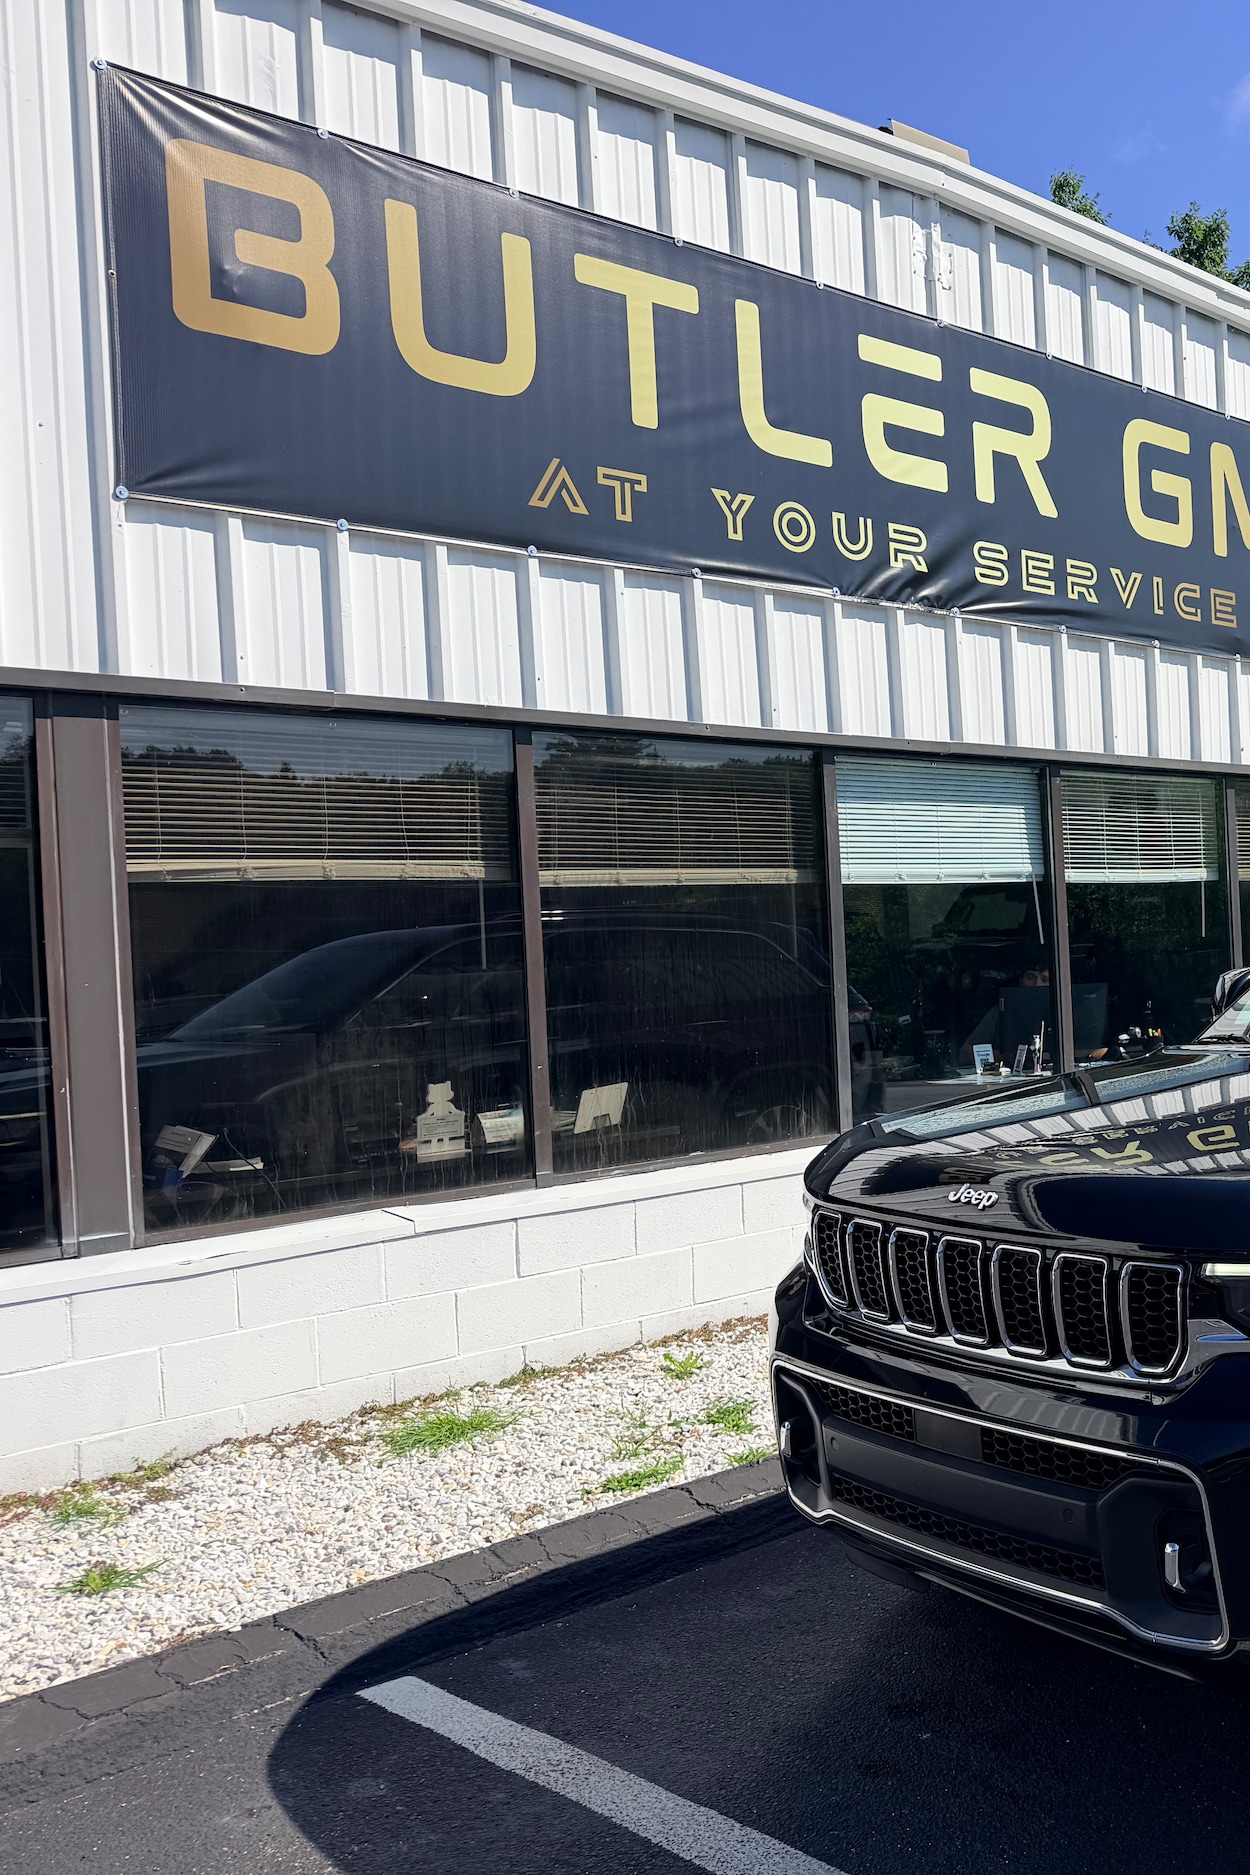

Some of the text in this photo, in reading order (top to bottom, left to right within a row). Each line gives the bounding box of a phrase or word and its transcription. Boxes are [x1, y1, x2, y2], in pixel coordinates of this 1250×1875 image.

[165, 138, 1059, 518] BUTLER
[528, 458, 1239, 629] AT YOUR SERVICE
[948, 1183, 999, 1210] Jeep
